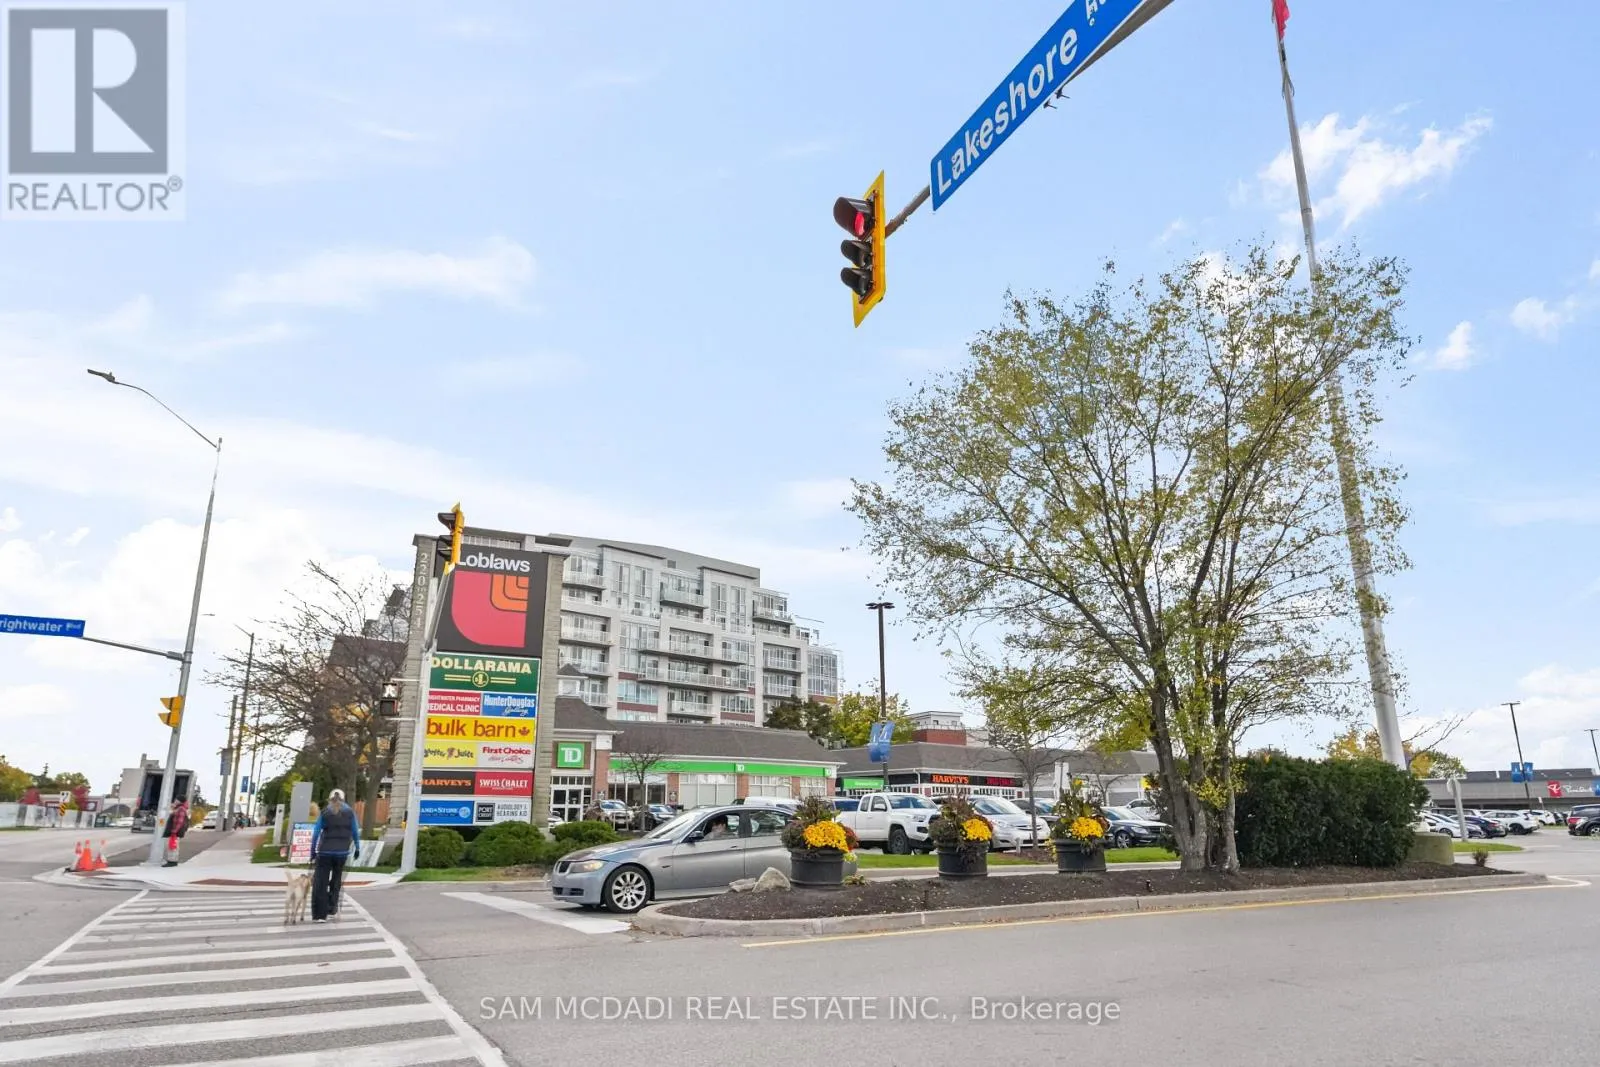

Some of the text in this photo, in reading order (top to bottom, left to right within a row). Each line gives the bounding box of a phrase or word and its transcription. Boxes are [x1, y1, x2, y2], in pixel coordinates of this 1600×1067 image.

[936, 28, 1078, 196] Lakeshore
[0, 618, 63, 632] rightwater
[431, 656, 532, 674] DOLLARAMA
[456, 703, 480, 713] CLINIC
[426, 718, 516, 737] bulk barn
[482, 746, 531, 755] First Choice
[561, 747, 582, 763] TD
[479, 777, 528, 788] SWISS CHALET
[932, 774, 969, 784] HARVEY'S
